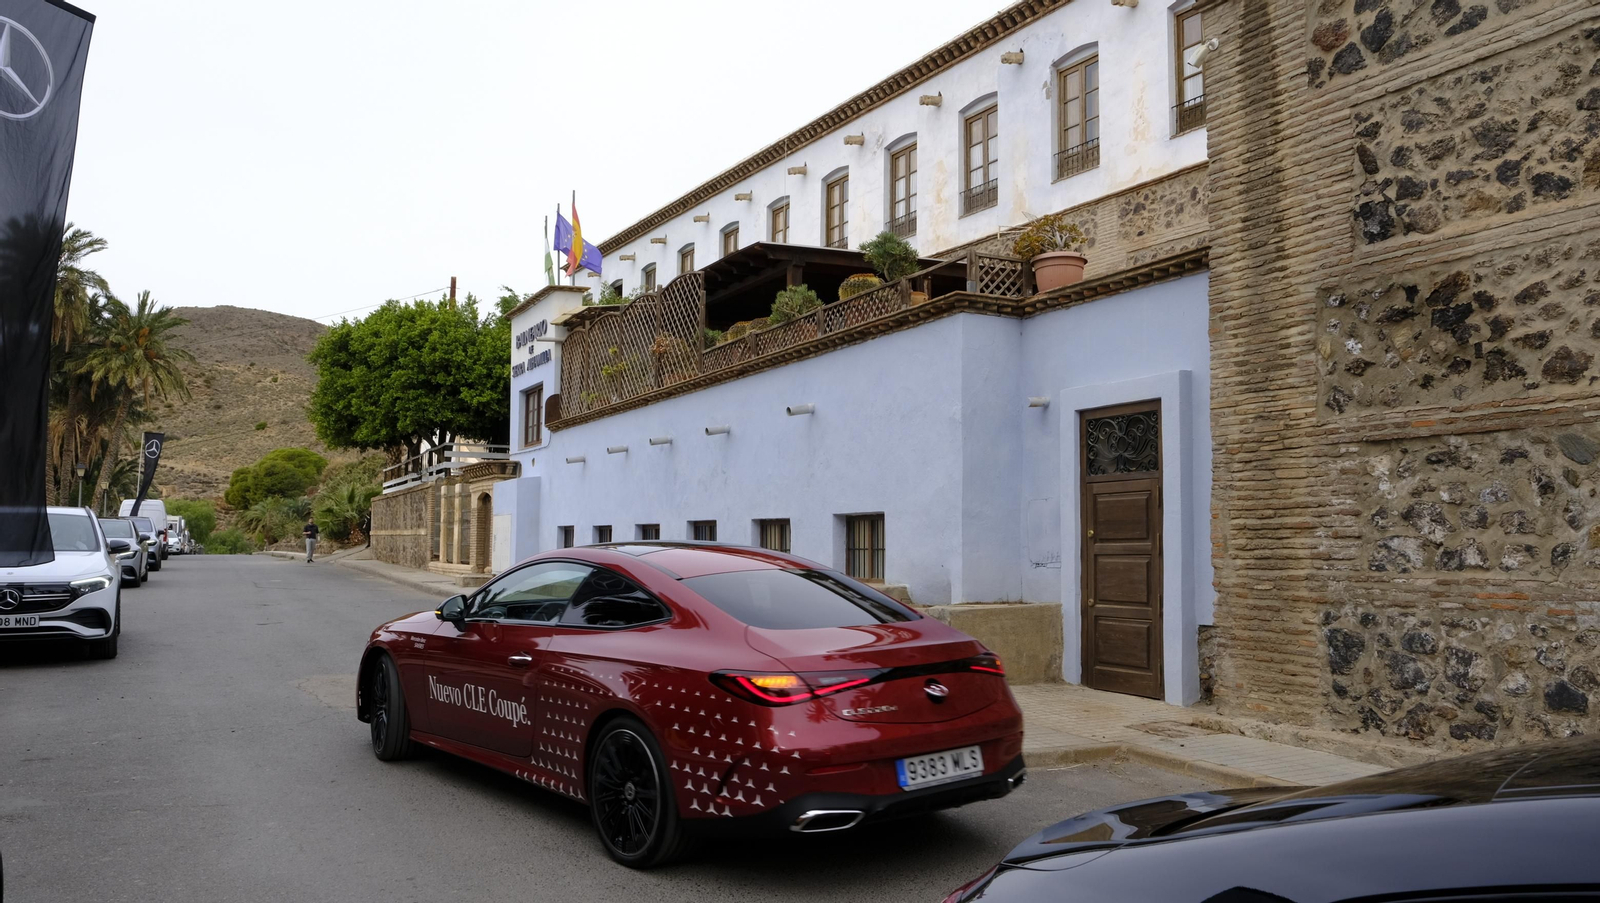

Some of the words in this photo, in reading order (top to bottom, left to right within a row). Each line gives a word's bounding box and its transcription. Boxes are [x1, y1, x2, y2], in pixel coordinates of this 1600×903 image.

[14, 616, 37, 626] MND
[428, 674, 462, 707] Nuevo
[463, 683, 487, 713] CLE
[488, 689, 532, 728] Coupé.
[906, 756, 949, 781] 9383
